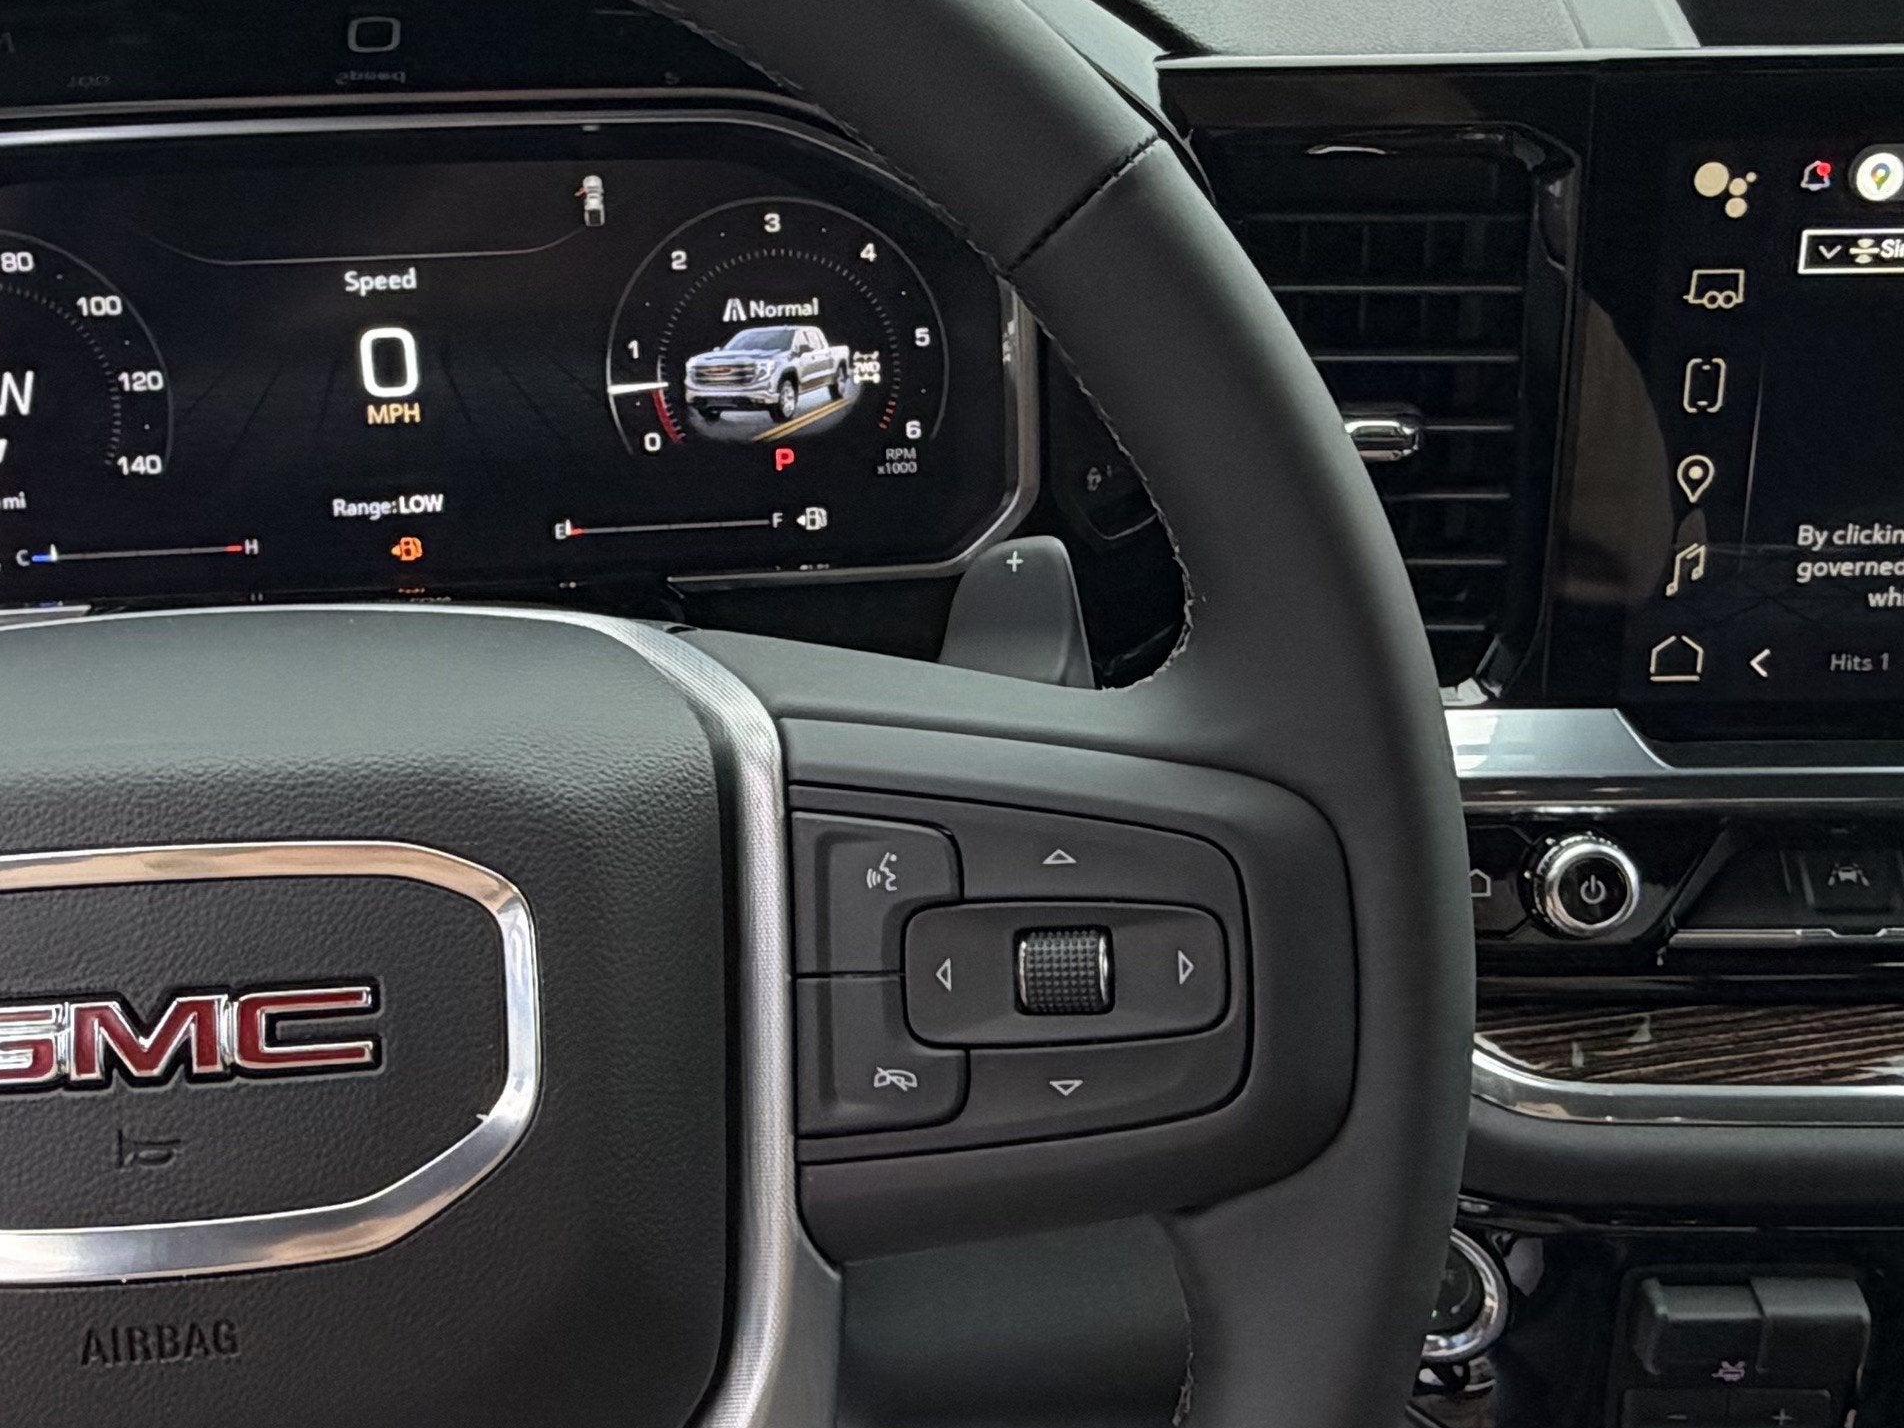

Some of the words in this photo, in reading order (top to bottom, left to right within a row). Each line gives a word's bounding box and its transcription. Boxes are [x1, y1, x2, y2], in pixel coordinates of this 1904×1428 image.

[763, 213, 781, 233] 3
[0, 251, 35, 274] 80
[670, 250, 688, 271] 2
[859, 243, 878, 263] 4
[344, 266, 418, 297] Speed
[76, 295, 124, 318] 100
[749, 297, 820, 320] Normal
[914, 327, 931, 347] 5
[627, 340, 641, 359] 1
[359, 326, 419, 399] 0
[118, 370, 165, 393] 120
[366, 402, 422, 425] MPH
[905, 420, 923, 440] 6
[643, 432, 662, 452] 0
[116, 454, 164, 476] 140
[774, 447, 796, 472] P
[885, 447, 918, 462] RPM
[876, 461, 919, 475] x1000
[332, 497, 397, 521] Range:
[398, 493, 444, 514] LOW
[771, 512, 784, 528] F
[243, 539, 259, 556] H
[1796, 524, 1829, 551] By
[15, 549, 31, 568] C
[1829, 653, 1874, 672] Hits
[1880, 653, 1891, 671] 1
[80, 1318, 241, 1367] AIRBAG
